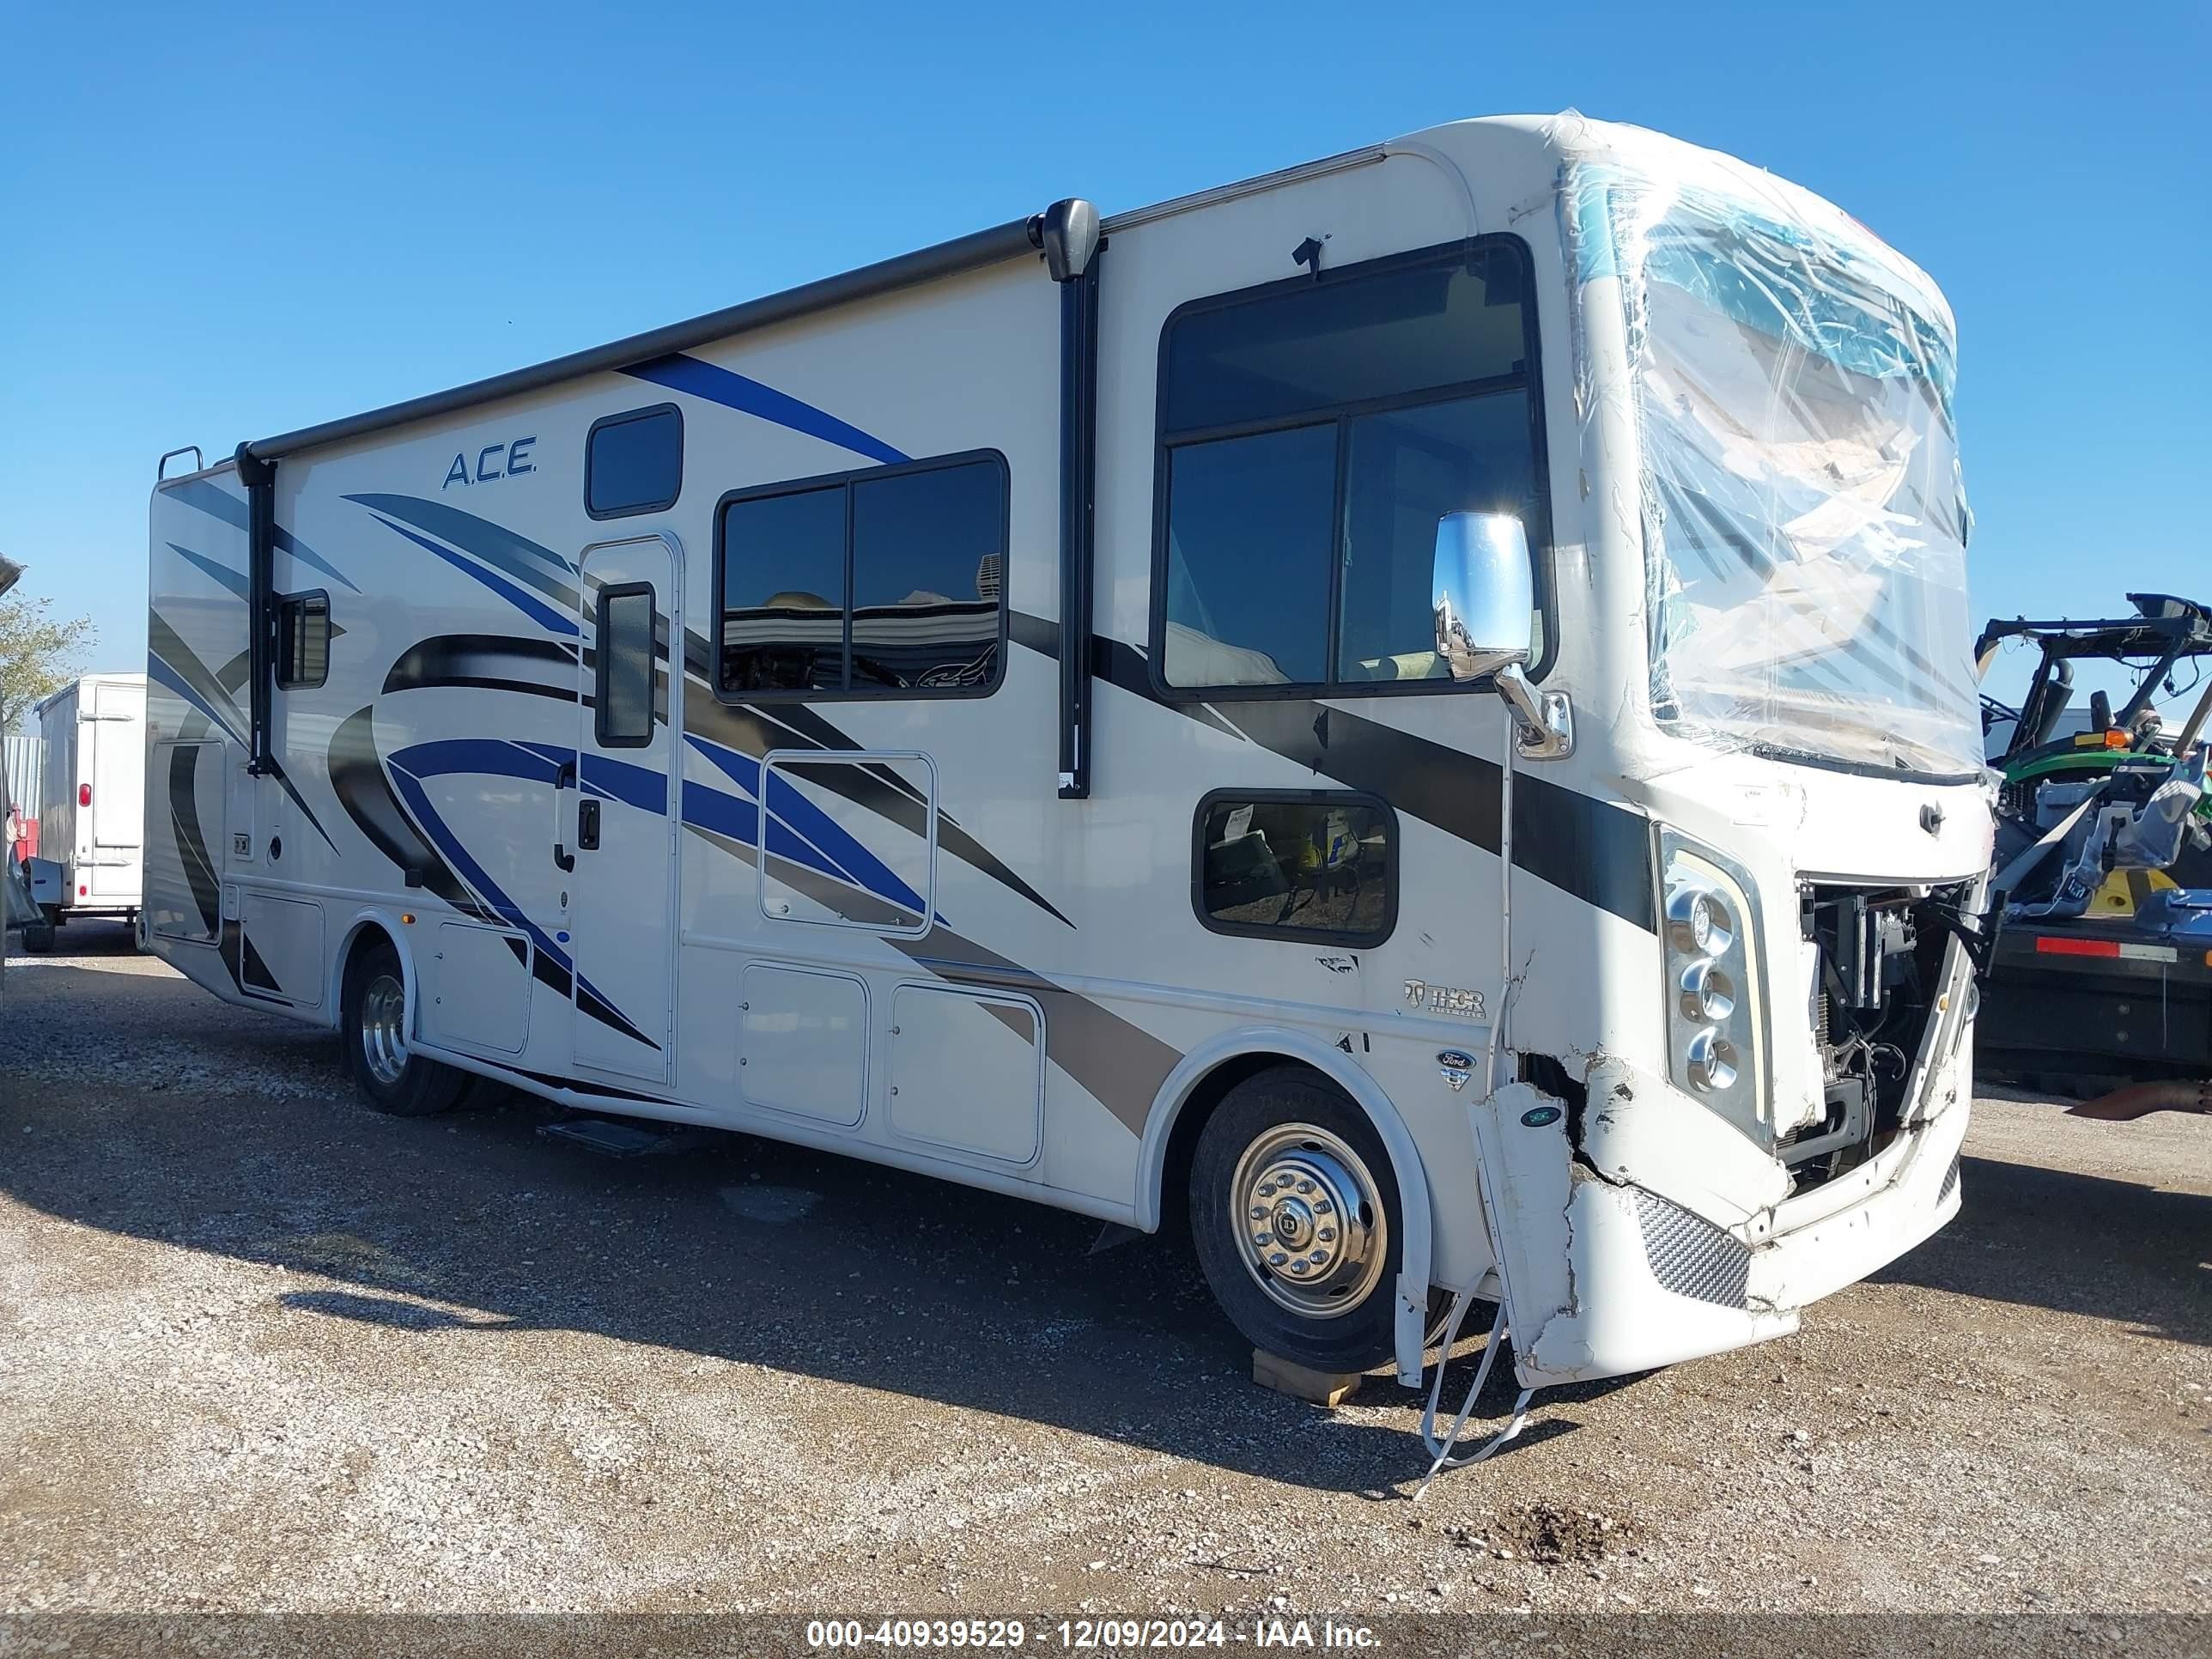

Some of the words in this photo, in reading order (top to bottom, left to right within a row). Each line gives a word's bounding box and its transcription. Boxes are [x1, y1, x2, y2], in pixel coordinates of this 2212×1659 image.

[440, 435, 537, 491] A.C.E.
[1427, 985, 1486, 1012] THOR
[1443, 1053, 1466, 1066] Ford
